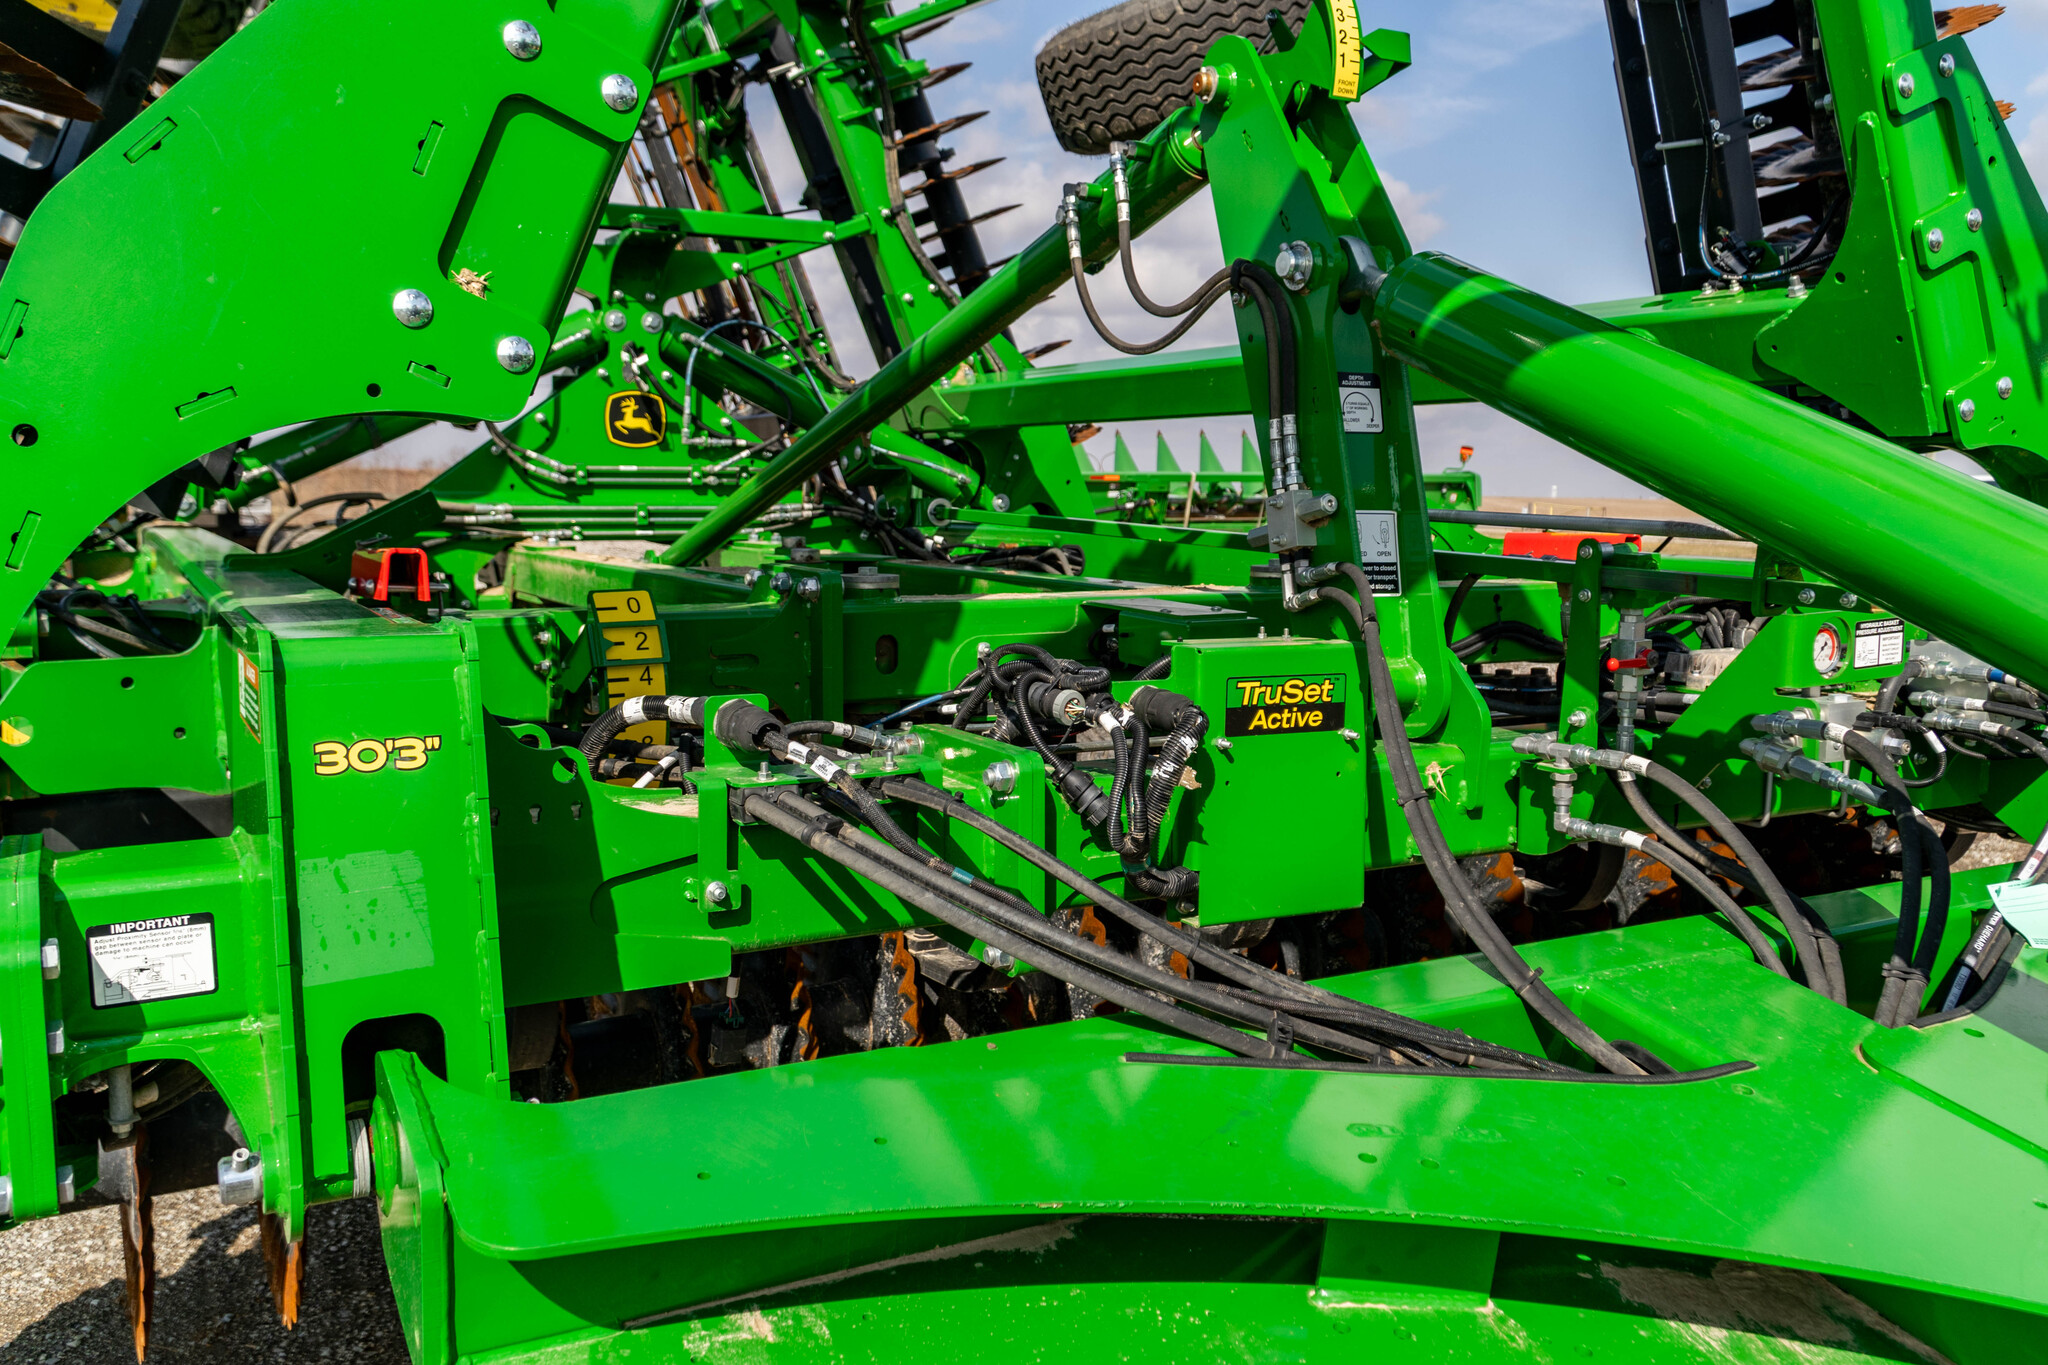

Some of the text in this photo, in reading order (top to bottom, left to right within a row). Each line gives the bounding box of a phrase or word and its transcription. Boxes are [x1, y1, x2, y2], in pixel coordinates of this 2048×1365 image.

[1336, 8, 1345, 22] 3
[1339, 29, 1347, 44] 2
[1340, 52, 1345, 68] 1
[627, 597, 641, 613] 0
[634, 632, 650, 650] 2
[640, 666, 653, 685] 4
[1248, 707, 1323, 730] Active
[110, 915, 190, 934] IMPORTANT
[109, 940, 137, 949] between
[117, 933, 147, 941] Proximity
